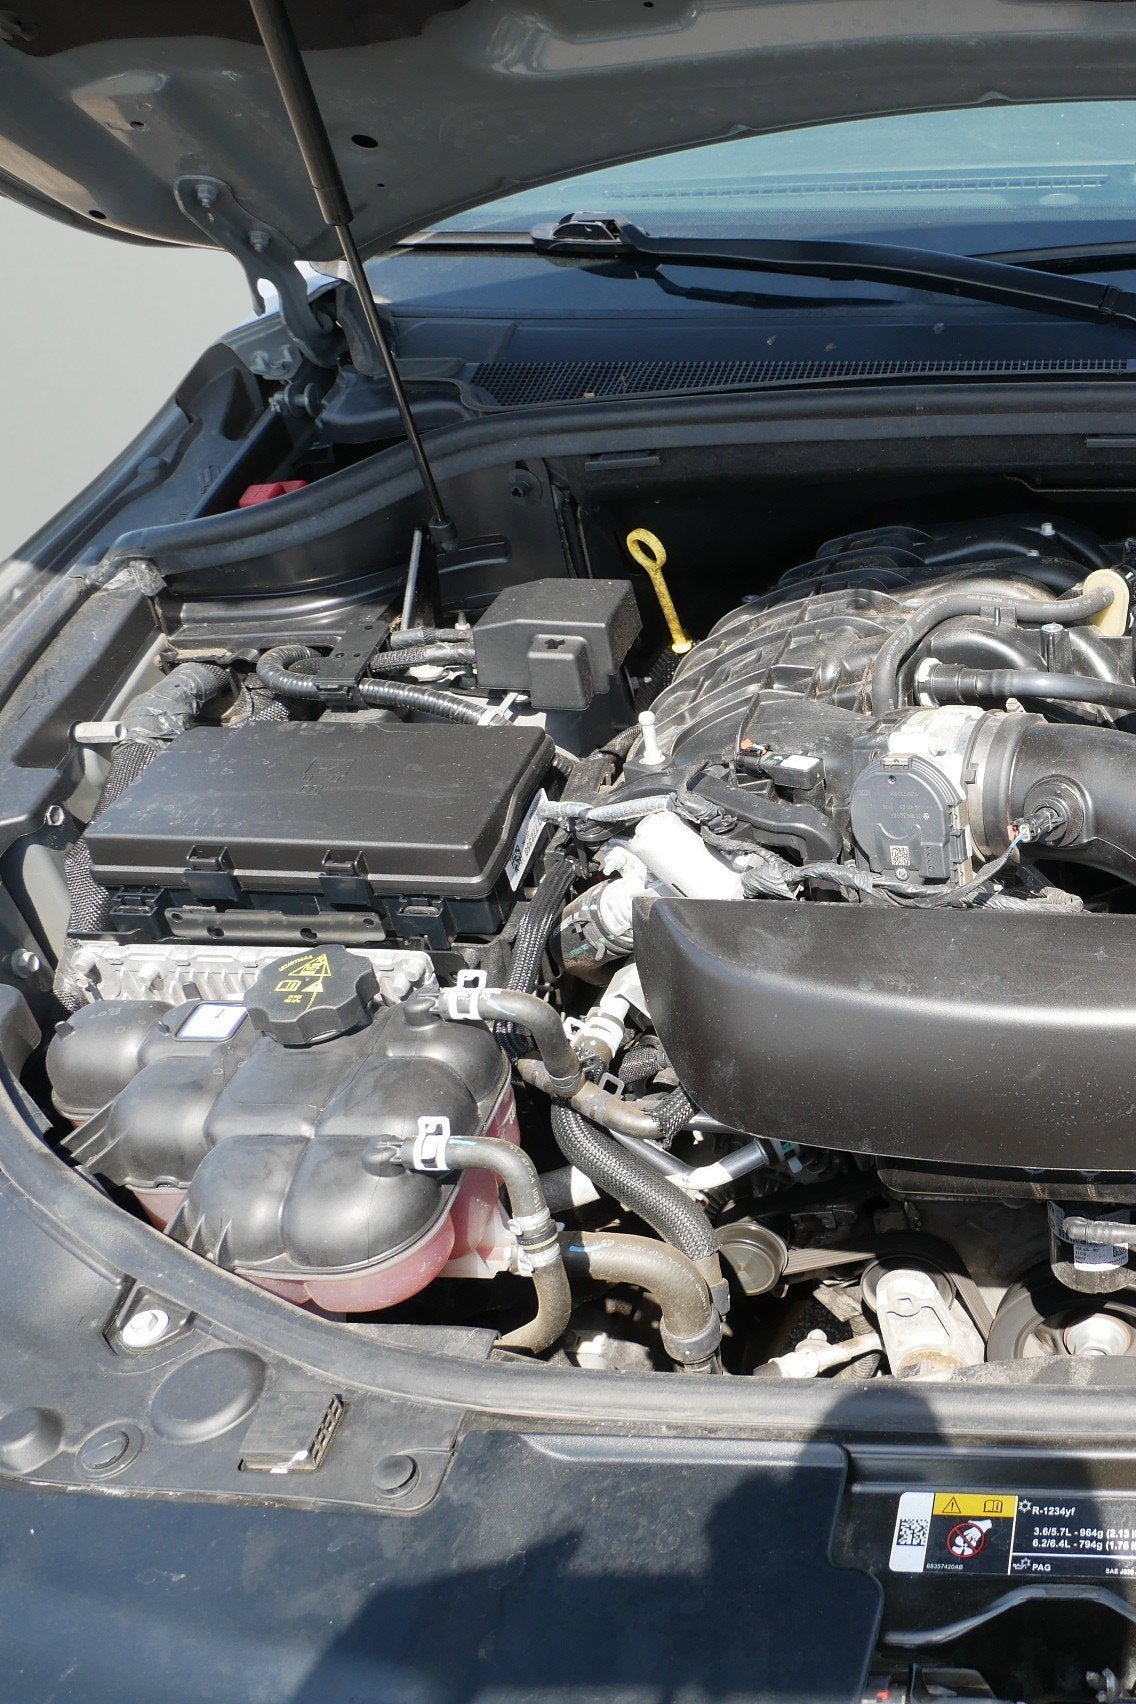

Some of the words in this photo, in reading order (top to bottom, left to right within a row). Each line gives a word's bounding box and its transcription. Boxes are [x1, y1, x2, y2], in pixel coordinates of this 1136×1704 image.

[1031, 1506, 1076, 1518] R-1234yf
[1033, 1526, 1072, 1537] 3.6/5.7L
[1079, 1528, 1103, 1539] 964g
[1032, 1538, 1071, 1549] 6.2/6.4L
[1079, 1540, 1103, 1551] 794g
[1032, 1563, 1052, 1572] PAG
[1105, 1567, 1119, 1575] SAE
